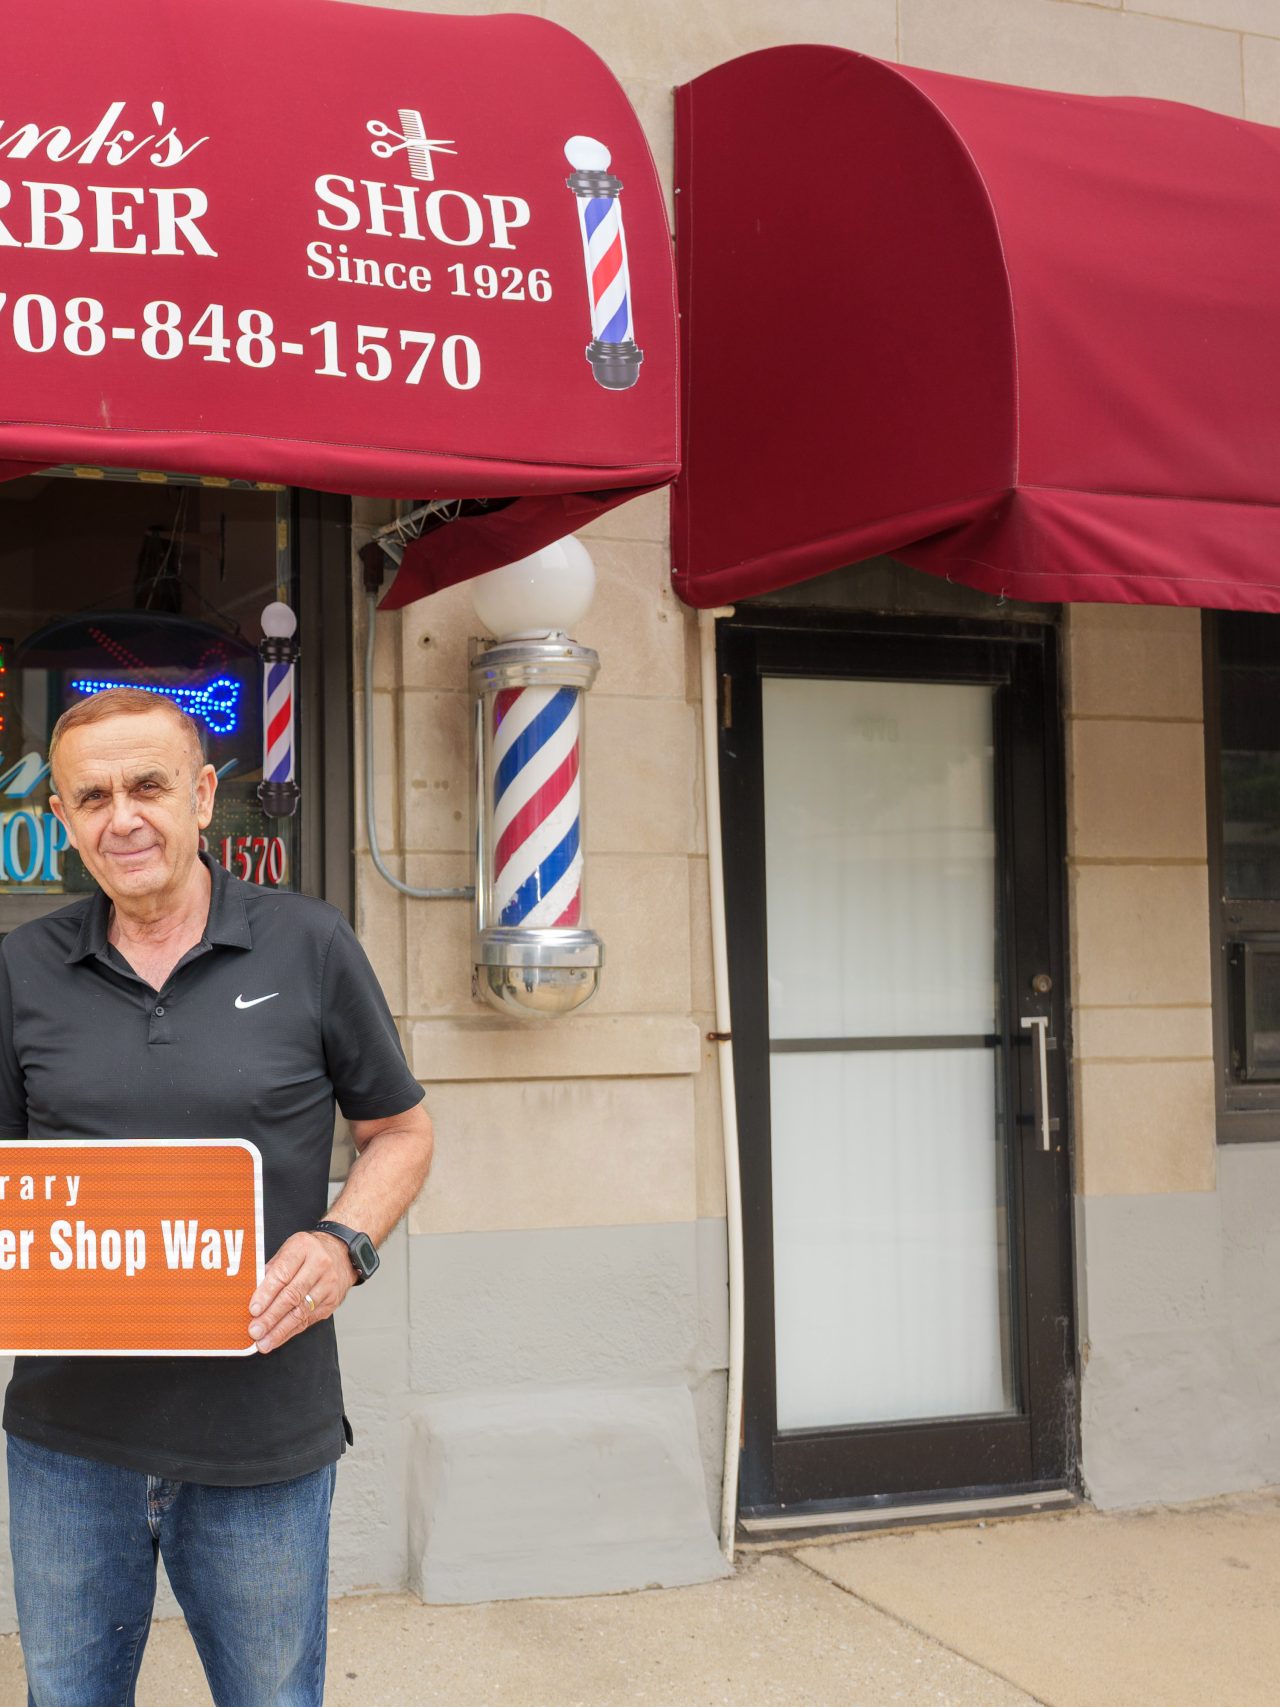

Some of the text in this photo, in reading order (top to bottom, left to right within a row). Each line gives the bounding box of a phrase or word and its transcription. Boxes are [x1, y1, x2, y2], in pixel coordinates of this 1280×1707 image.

[314, 174, 531, 250] SHOP
[306, 241, 553, 303] Since 1926
[197, 834, 287, 885] 1570
[49, 1219, 147, 1277] Shop
[161, 1219, 245, 1277] Way
